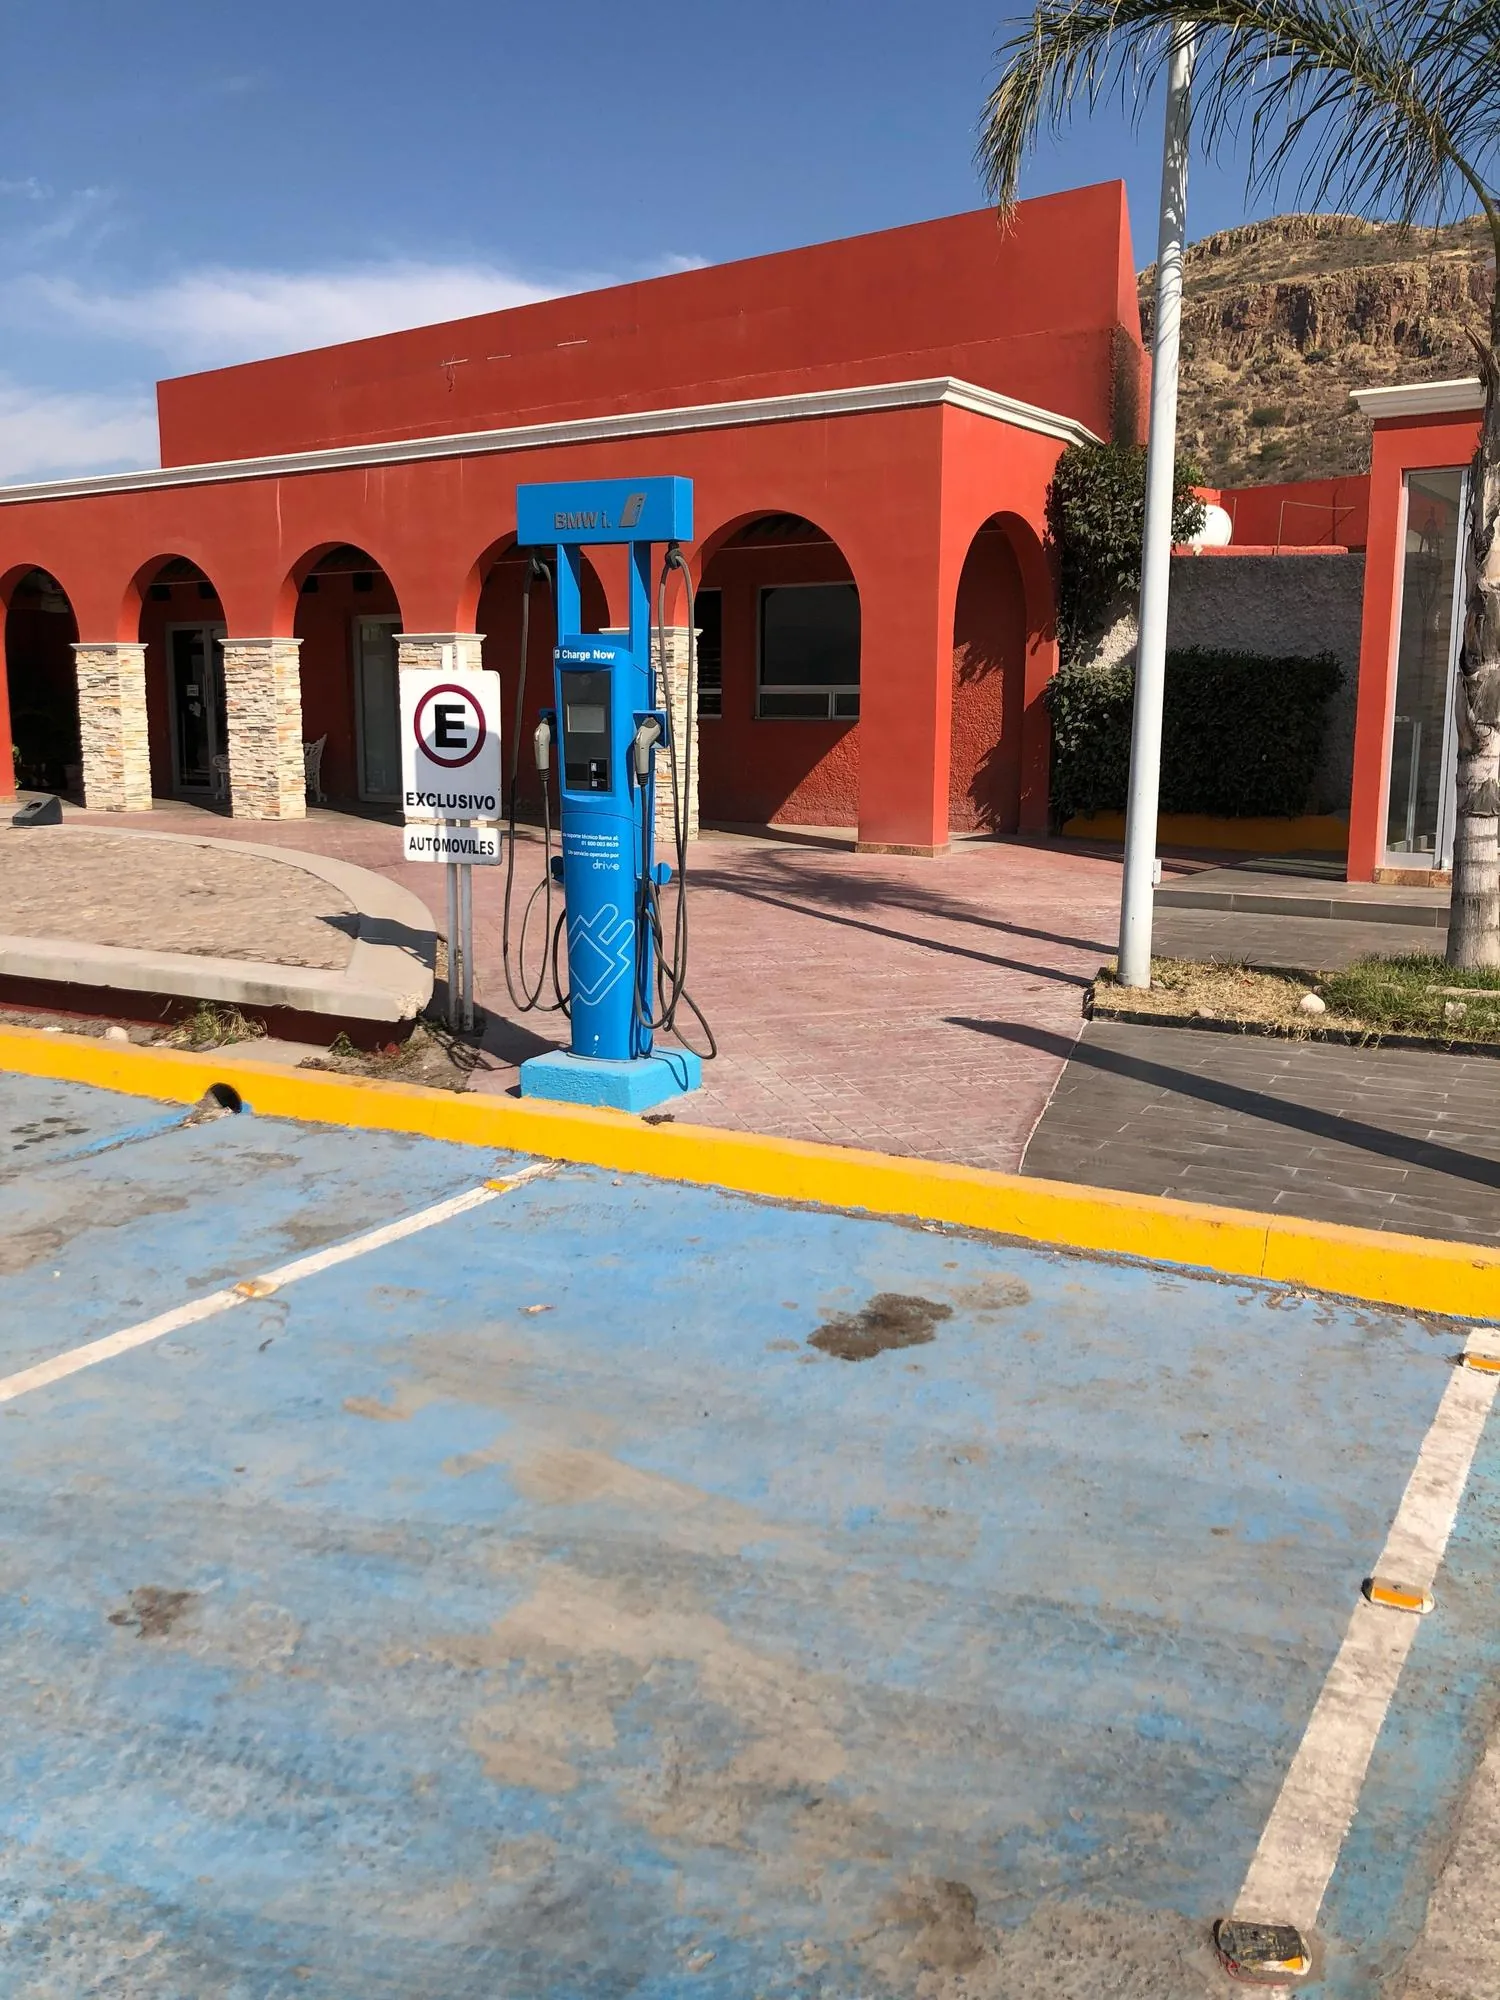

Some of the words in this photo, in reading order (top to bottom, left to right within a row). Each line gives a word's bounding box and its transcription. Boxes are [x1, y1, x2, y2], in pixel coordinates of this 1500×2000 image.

[554, 511, 598, 529] BMW
[562, 649, 590, 661] Charge
[593, 649, 615, 660] Now
[434, 704, 468, 748] E
[406, 792, 496, 810] EXCLUSIVO
[409, 837, 494, 855] AUTOMOVILES
